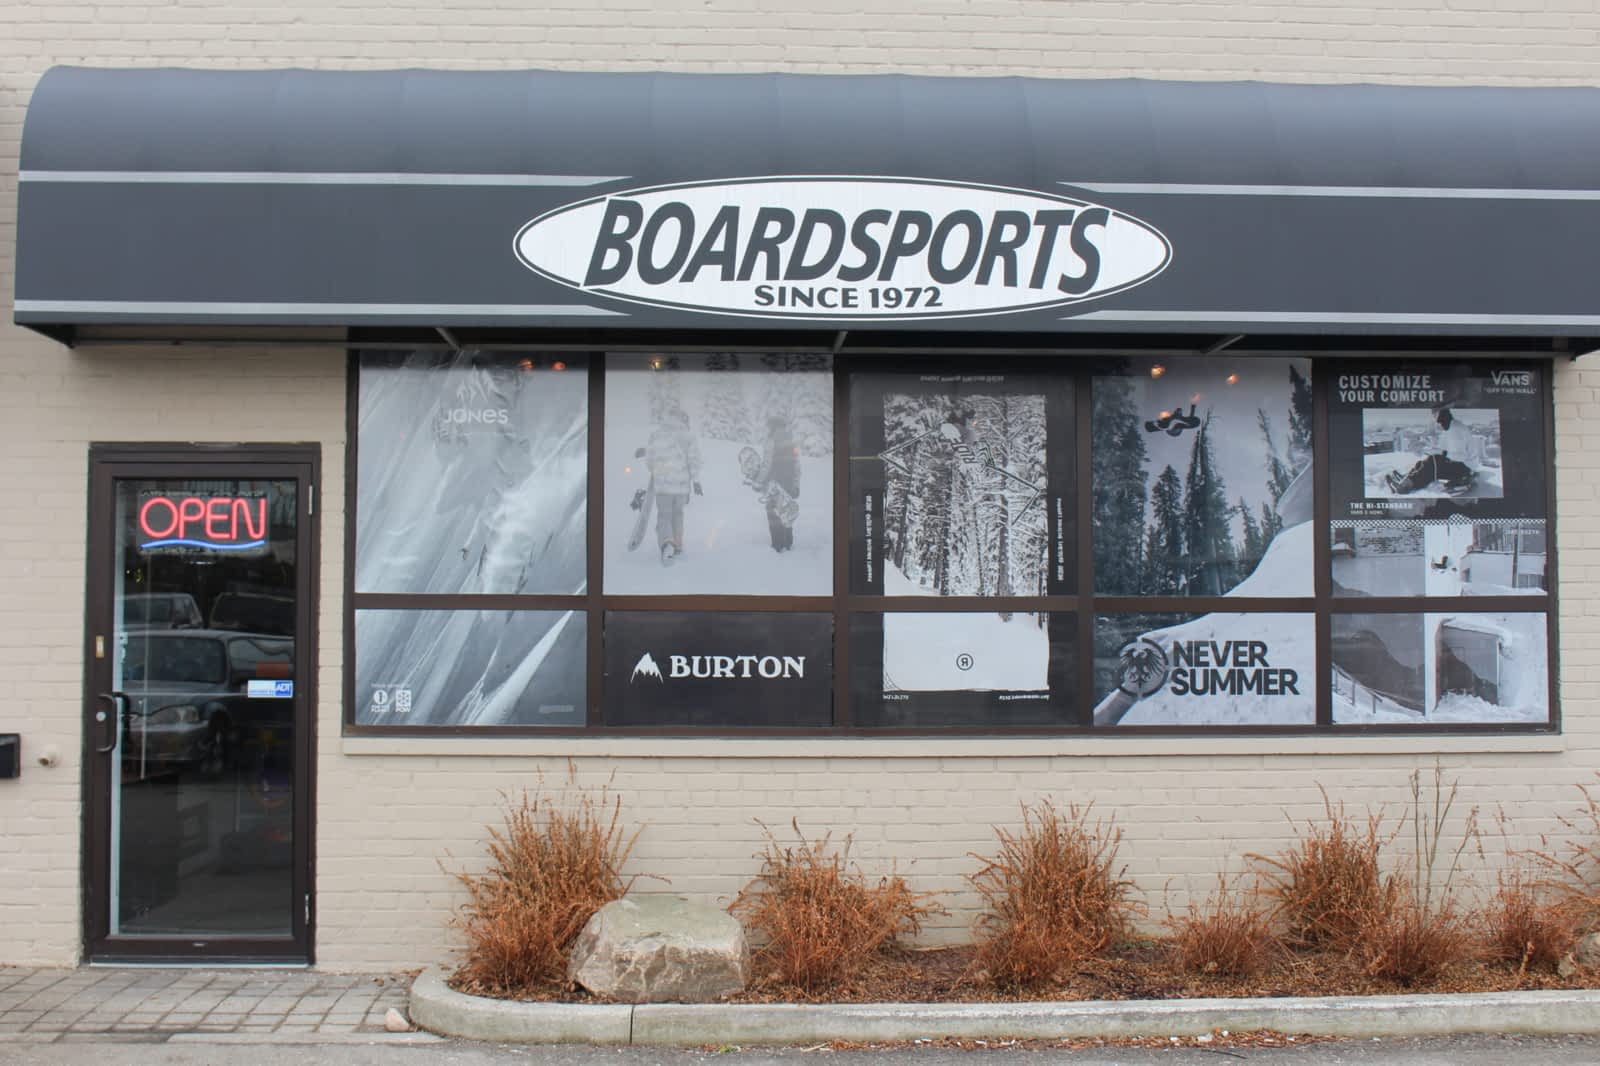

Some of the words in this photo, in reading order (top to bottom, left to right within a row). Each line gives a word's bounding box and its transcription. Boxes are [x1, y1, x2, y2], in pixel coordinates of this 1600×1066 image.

[583, 198, 1110, 294] BOARDSPORTS
[754, 285, 860, 308] SINCE
[868, 286, 943, 308] 1972
[1339, 375, 1431, 389] CUSTOMIZE
[1491, 370, 1532, 386] VANS
[1339, 390, 1375, 402] YOUR
[1381, 390, 1445, 402] COMFORT
[139, 496, 267, 540] OPEN
[1172, 640, 1270, 667] NEVER
[669, 655, 806, 678] BURTON
[1170, 668, 1301, 696] SUMMER
